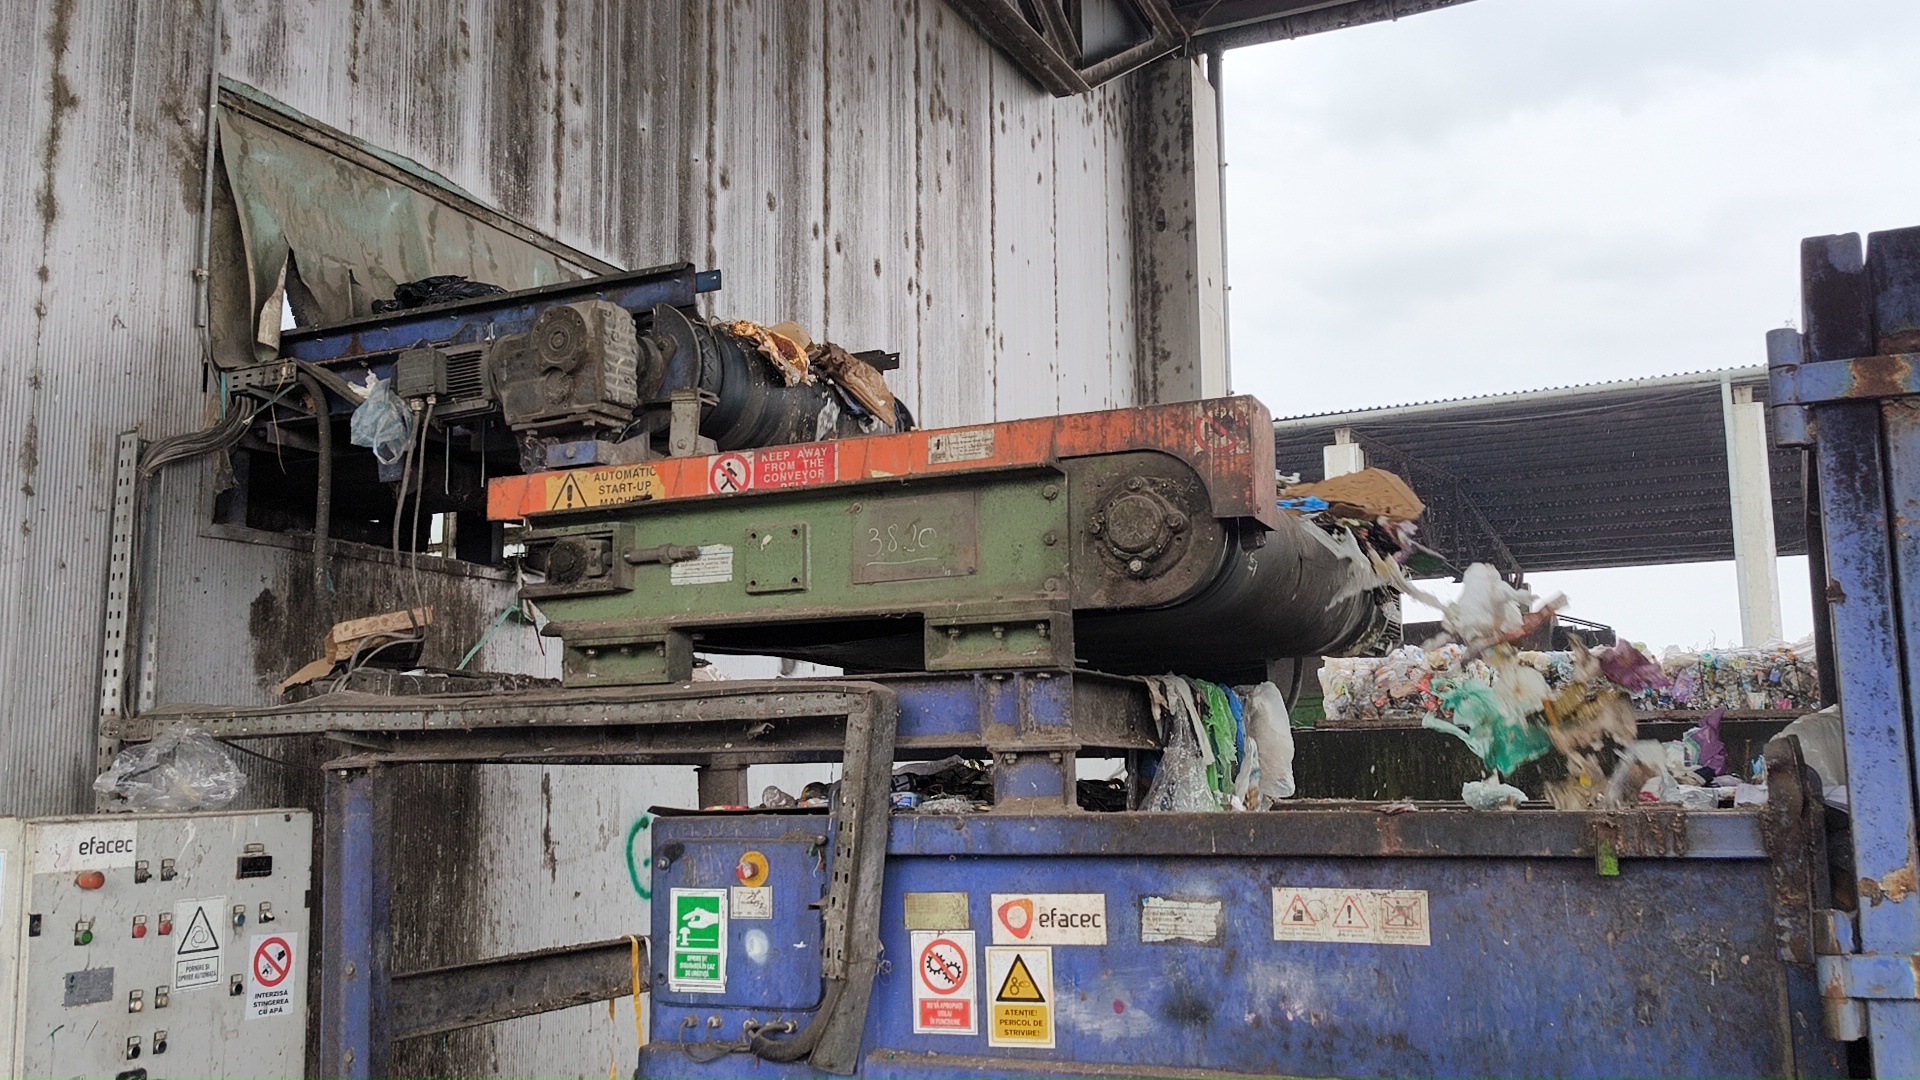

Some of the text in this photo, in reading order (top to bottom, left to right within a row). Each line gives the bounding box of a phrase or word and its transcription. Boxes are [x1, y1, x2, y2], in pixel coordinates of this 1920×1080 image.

[762, 447, 828, 462] KEEP AWAY
[764, 458, 825, 473] FROM THE
[594, 466, 657, 483] AUTOMATIC
[763, 468, 825, 484] CONVEYOR
[598, 480, 652, 495] START-UP
[79, 836, 133, 855] efacec
[1038, 907, 1102, 928] efacec
[253, 998, 289, 1008] STINGEREA
[1004, 1009, 1038, 1018] ATENȚIE!
[999, 1019, 1044, 1027] PERICOL DE
[1004, 1029, 1040, 1037] STRIVIRE!
